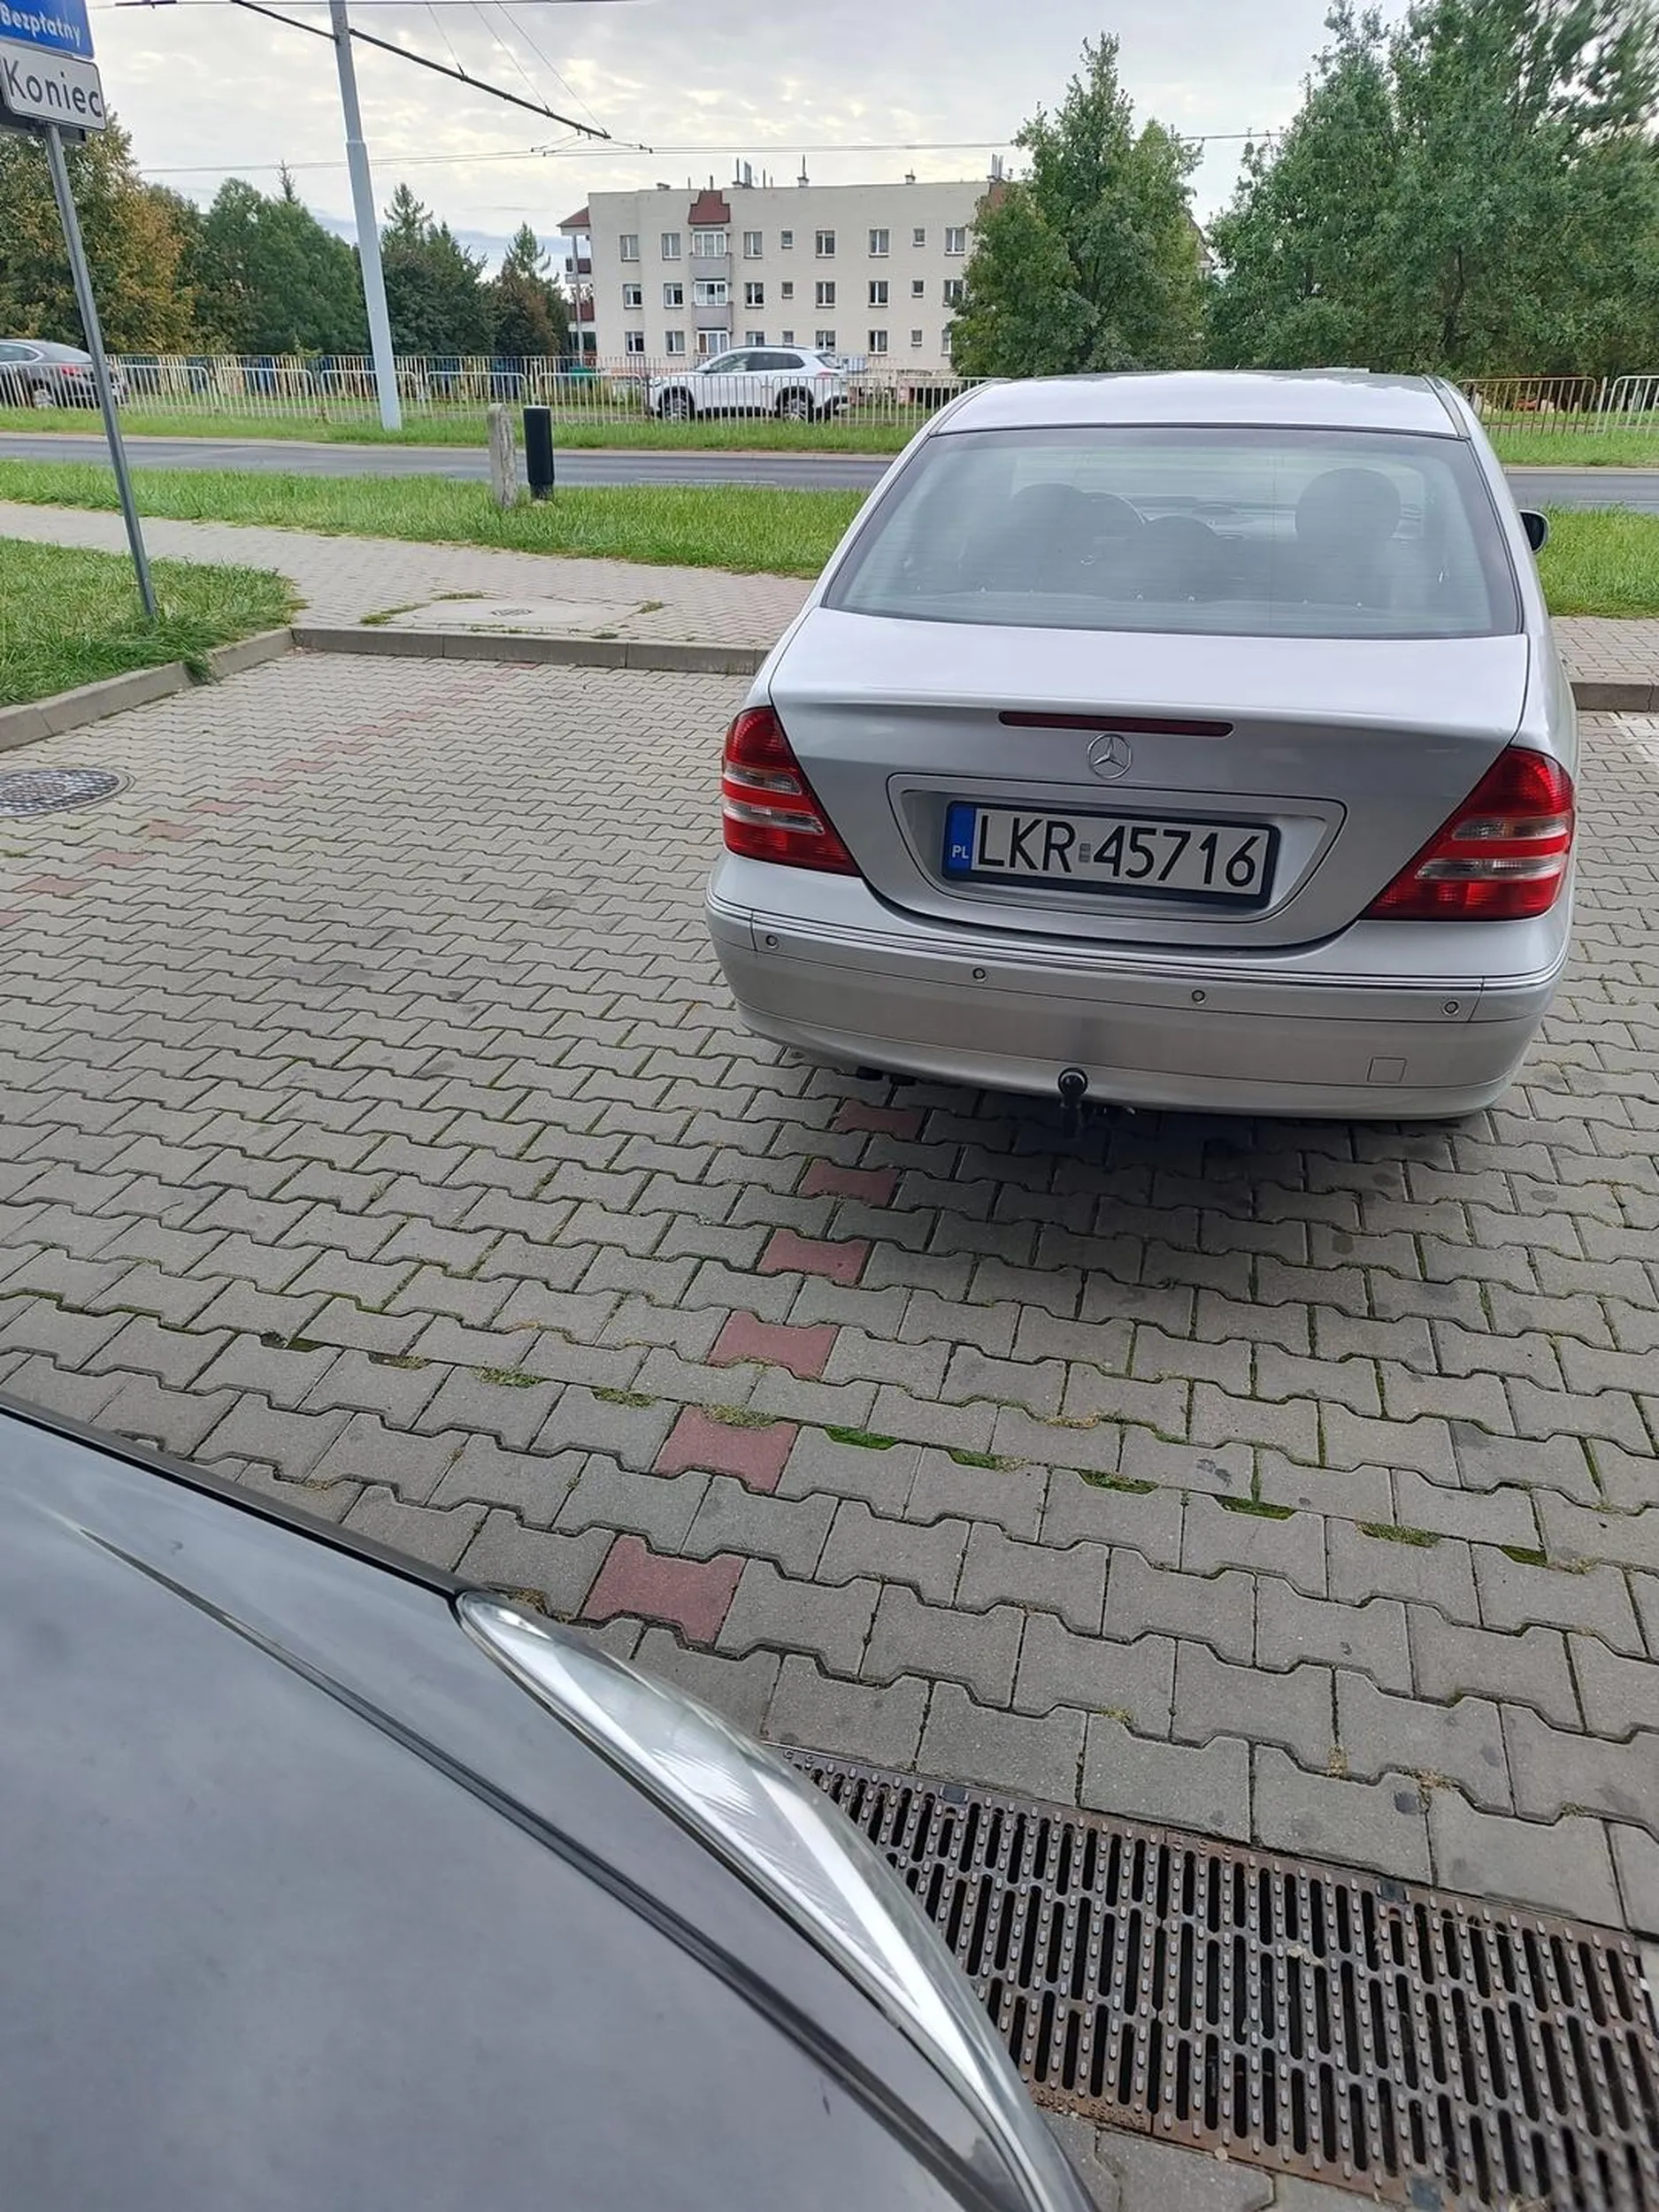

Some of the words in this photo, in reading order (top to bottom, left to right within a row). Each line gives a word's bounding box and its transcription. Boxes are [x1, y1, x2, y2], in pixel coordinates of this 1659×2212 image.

[2, 57, 103, 117] Koniec
[951, 845, 970, 860] PL
[978, 815, 1075, 873] LKR
[1093, 825, 1260, 887] 45716
